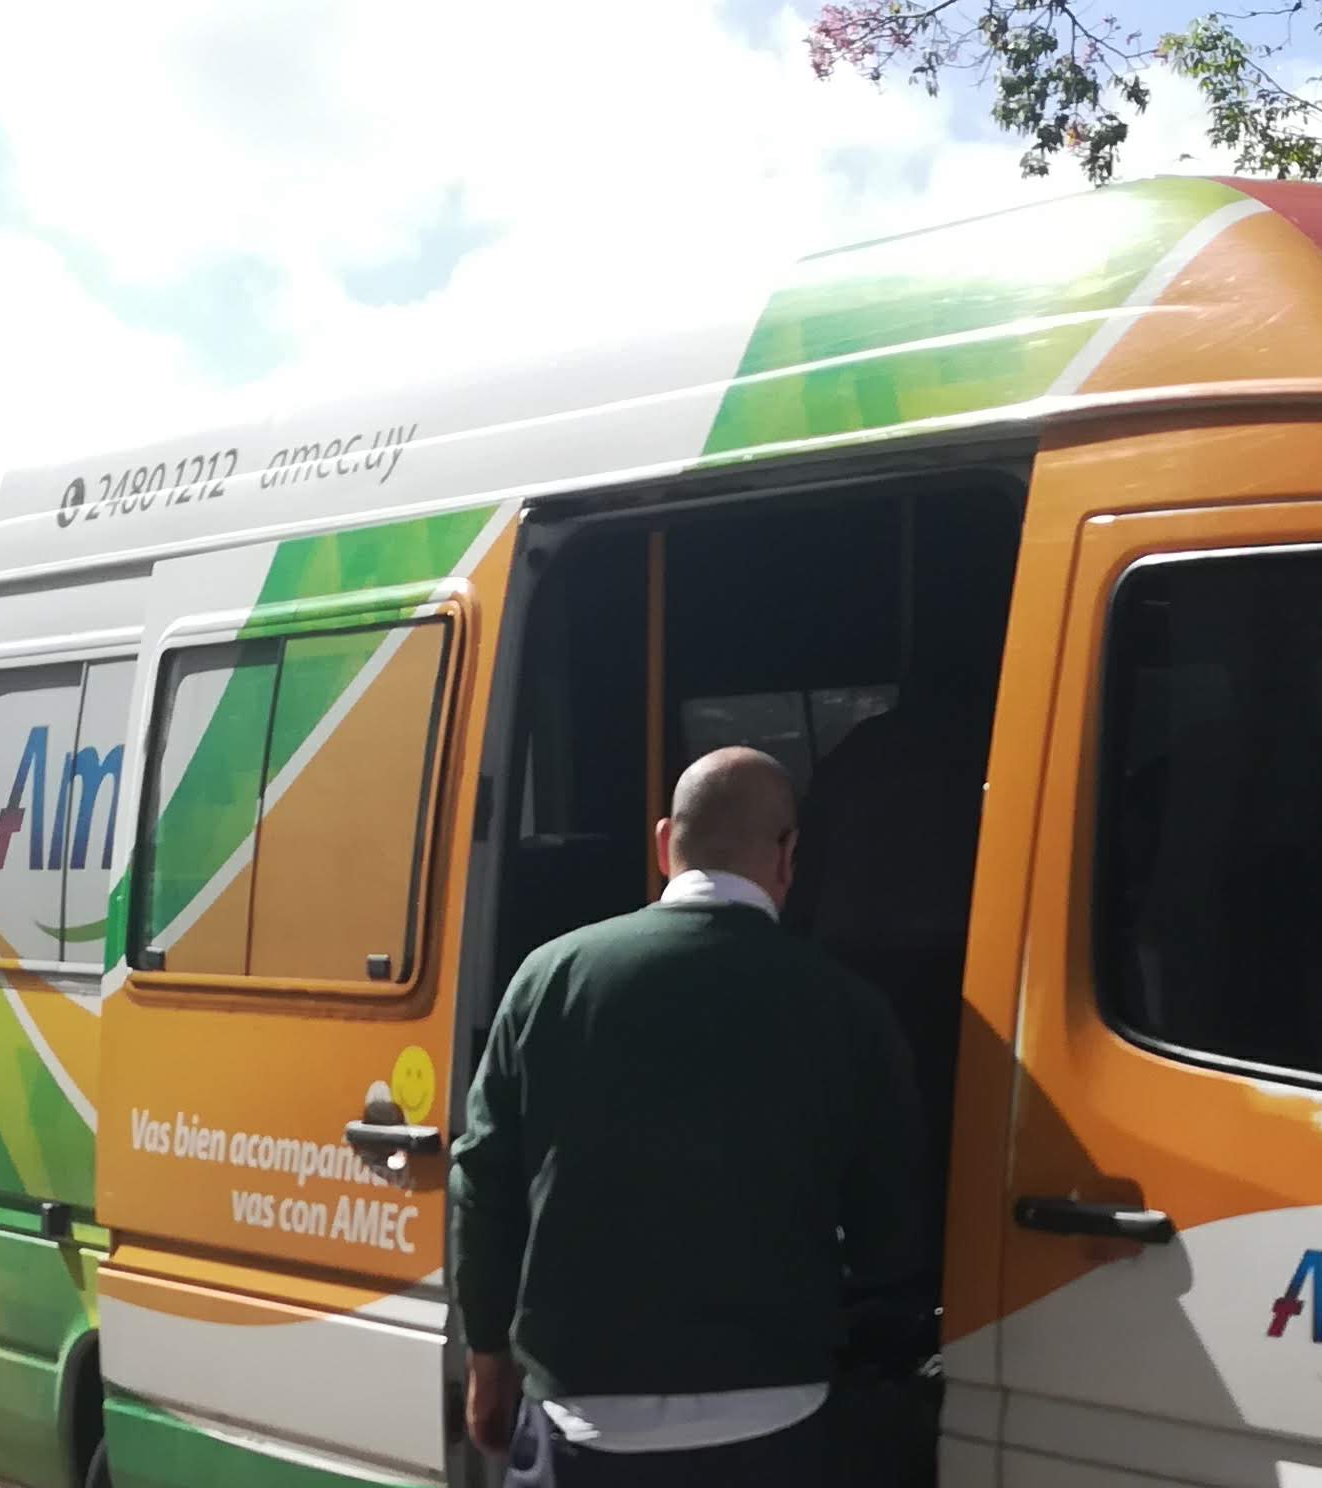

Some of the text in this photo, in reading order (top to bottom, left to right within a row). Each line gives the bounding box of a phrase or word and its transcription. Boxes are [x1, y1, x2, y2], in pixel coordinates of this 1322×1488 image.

[260, 424, 417, 489] amec.uy
[131, 1107, 171, 1154] Vas
[174, 1111, 226, 1163] bien
[231, 1189, 420, 1254] vas con AMEC
